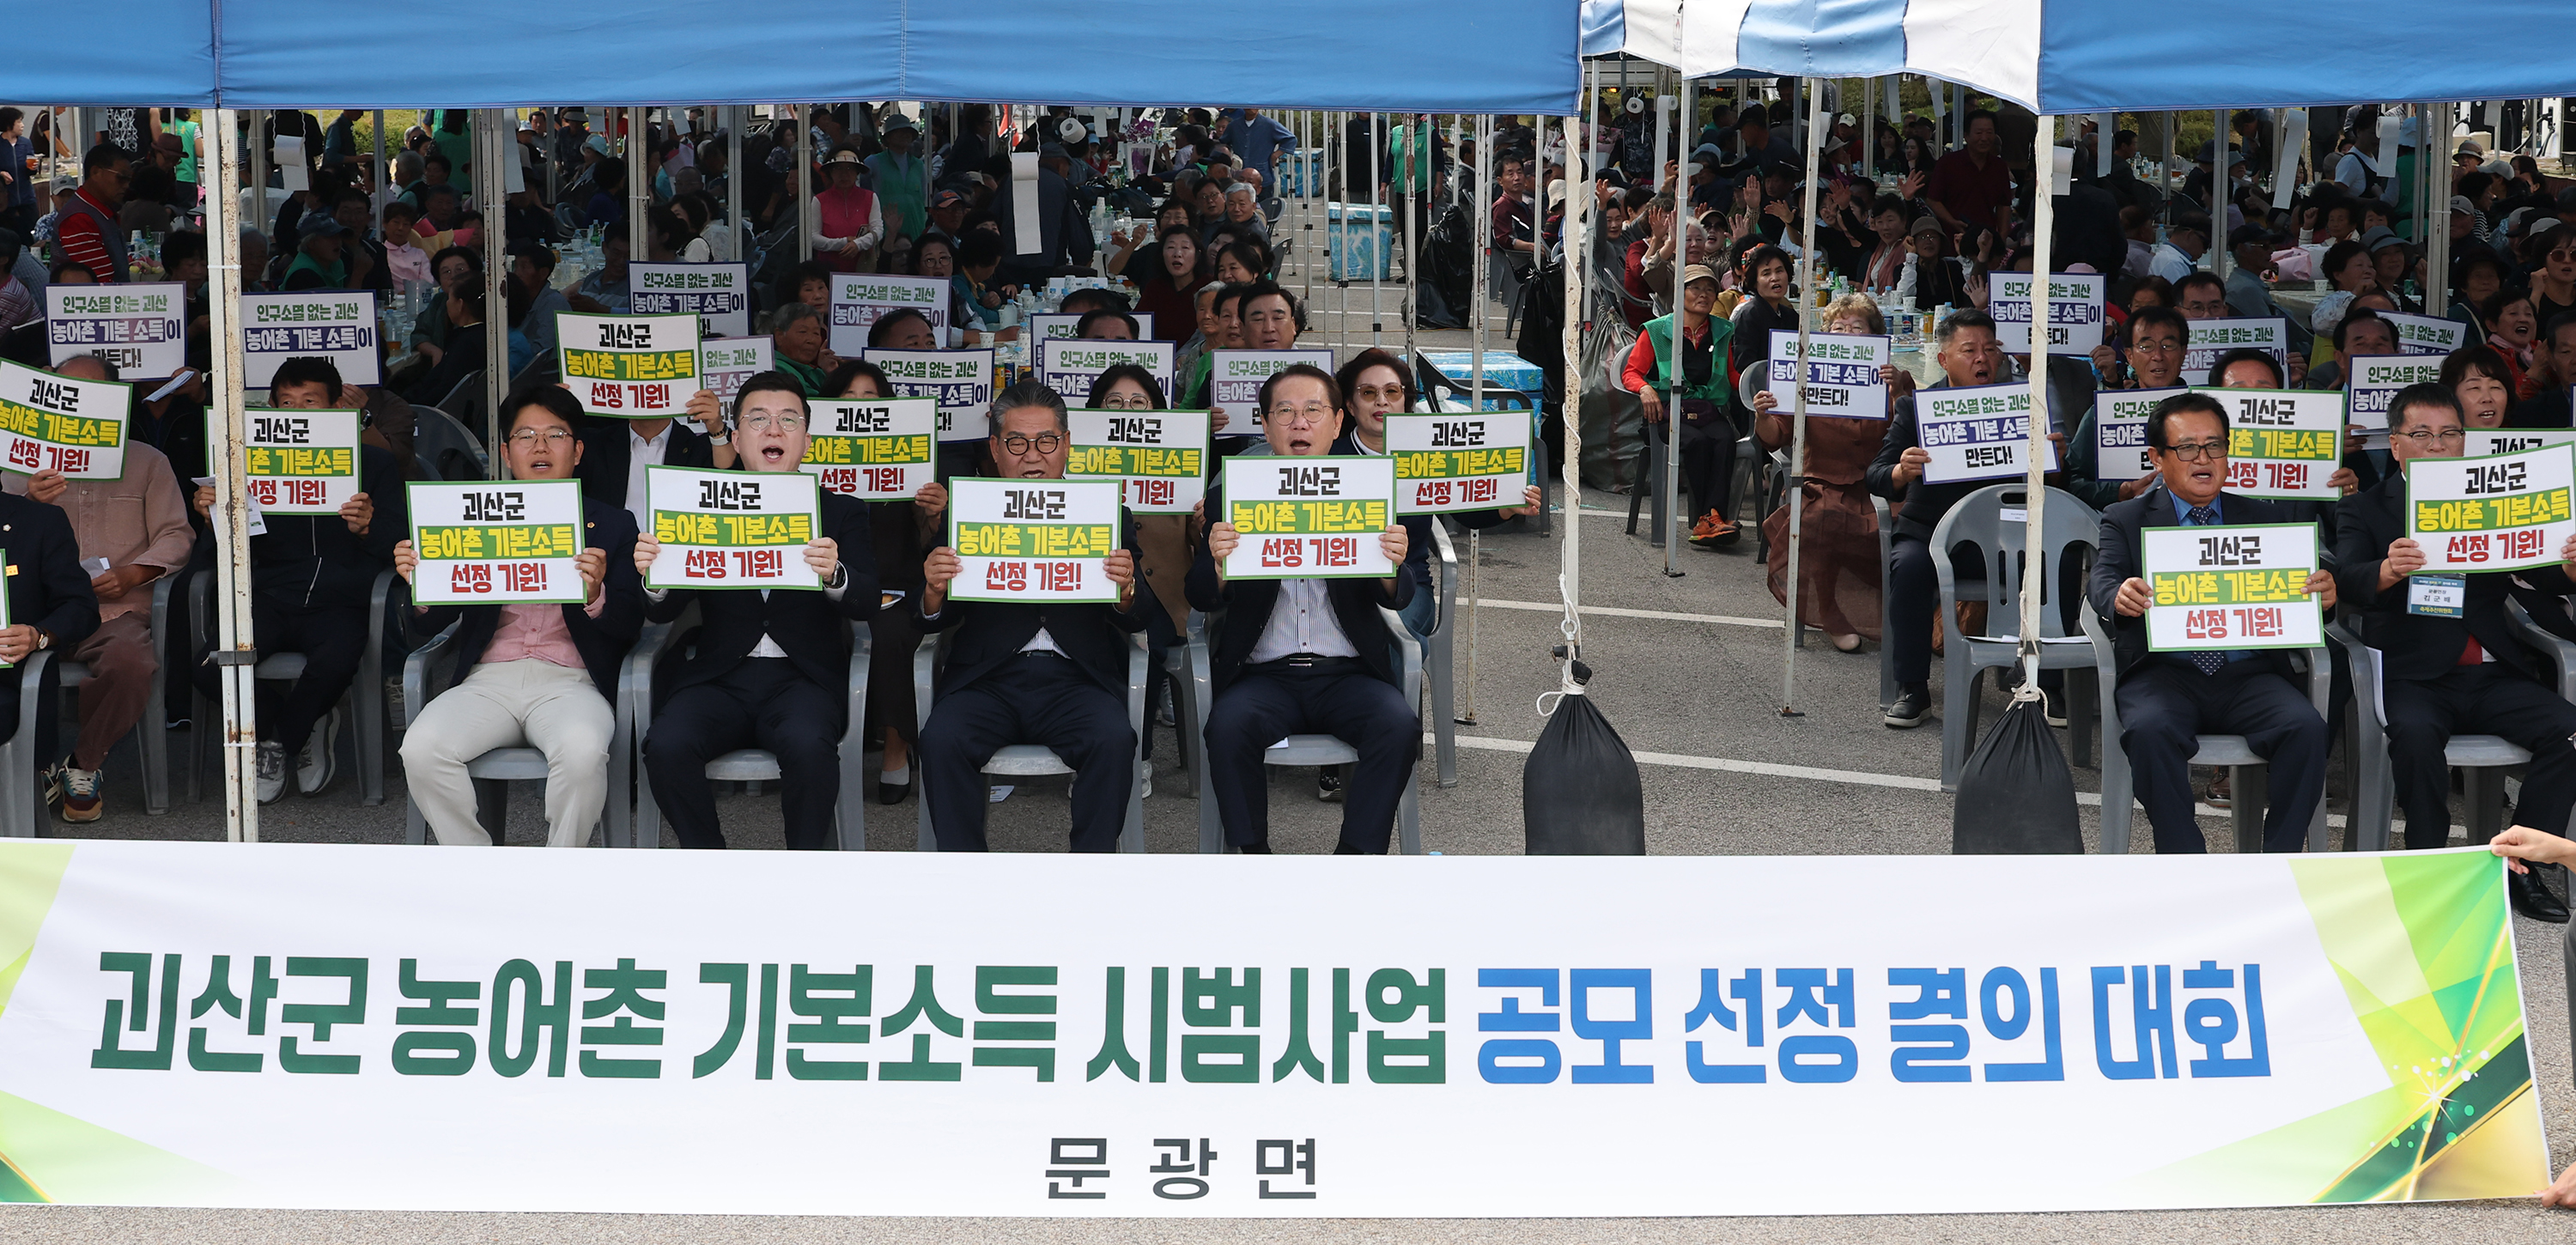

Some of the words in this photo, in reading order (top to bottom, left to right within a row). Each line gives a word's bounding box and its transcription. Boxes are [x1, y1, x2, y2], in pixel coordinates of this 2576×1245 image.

[106, 108, 134, 119] HARD
[644, 272, 684, 288] 인구소멸
[687, 273, 708, 288] 없는
[711, 272, 732, 288] 괴산
[2070, 283, 2091, 299] 괴산
[63, 295, 112, 314] 인구소멸
[114, 295, 139, 313] 없는
[143, 295, 167, 313] 괴산
[634, 294, 671, 313] 농어촌
[674, 294, 700, 313] 기본
[703, 293, 744, 313] 소득이
[846, 284, 888, 301] 인구소멸
[890, 285, 911, 301] 없는
[914, 287, 935, 302] 괴산
[257, 304, 304, 322] 인구소멸
[307, 303, 331, 321] 없는
[334, 302, 358, 320] 괴산
[835, 304, 873, 325] 농어촌
[1994, 302, 2032, 321] 농어촌
[2063, 304, 2100, 323] 소득이
[52, 319, 95, 343] 농어촌
[99, 320, 129, 342] 기본
[134, 319, 181, 341] 소득이
[246, 328, 290, 351] 농어촌
[293, 328, 323, 349] 기본
[326, 327, 373, 349] 소득이
[598, 324, 651, 349] 괴산군
[2189, 328, 2229, 345] 인구소멸
[2232, 327, 2252, 343] 없는
[2254, 326, 2274, 343] 괴산
[2417, 325, 2437, 343] 없는
[2437, 328, 2454, 345] 괴산
[706, 350, 730, 368] 없는
[733, 348, 756, 366] 괴산
[1060, 350, 1106, 368] 인구소멸
[1785, 341, 1827, 358] 인소멸
[1829, 343, 1850, 360] 없는
[1853, 345, 1874, 361] 괴산
[566, 350, 616, 379] 농어촌
[619, 351, 693, 380] 기본소득
[880, 360, 927, 378] 인구소멸
[929, 361, 952, 379] 없는
[955, 361, 978, 378] 괴산
[1228, 361, 1271, 376] 인구소멸
[1815, 364, 1841, 383] 기본
[2368, 366, 2414, 384] 인구소멸
[2417, 365, 2439, 383] 없는
[29, 378, 79, 412] 괴산군
[591, 382, 623, 409] 선정
[628, 384, 670, 409] 기원!
[945, 384, 988, 406] 소득이
[1048, 374, 1090, 396] 농어촌
[1218, 382, 1256, 401] 농어촌
[1807, 387, 1849, 406] 만든다!
[1933, 398, 1979, 417] 인구소멸
[1981, 397, 2005, 415] 없는
[2008, 393, 2030, 411] 괴산
[2239, 398, 2295, 425] 괴산군
[0, 401, 39, 437] 농어촌
[44, 413, 118, 446] 기본소득
[253, 418, 309, 443] 괴산군
[836, 408, 890, 433] 괴산군
[1108, 418, 1162, 443] 괴산군
[1924, 422, 1967, 446] 농어촌
[1970, 420, 1999, 441] 기본
[1431, 422, 1485, 446] 괴산군
[2102, 423, 2145, 446] 농어촌
[2259, 430, 2334, 459] 기본소득
[9, 438, 41, 468] 선정
[46, 446, 89, 472] 기원!
[857, 435, 928, 463] 기본소득
[1068, 446, 1122, 473] 농어촌
[1128, 448, 1200, 476] 기본소득
[1965, 446, 2014, 468] 만든다!
[276, 449, 351, 475] 기본소득
[1394, 452, 1447, 477] 농어촌
[1452, 448, 1522, 475] 기본소득
[821, 468, 856, 493] 선정
[863, 468, 904, 492] 기원!
[1279, 467, 1340, 495] 괴산군
[2264, 464, 2307, 489] 기원!
[2465, 461, 2526, 495] 괴산군
[283, 480, 326, 505] 기원!
[699, 480, 761, 510] 괴산군
[1004, 490, 1066, 519] 괴산군
[1133, 480, 1174, 505] 기원!
[1416, 481, 1451, 506] 선정
[1457, 479, 1498, 502] 기원!
[462, 492, 525, 521] 괴산군
[1234, 501, 1296, 532] 농어촌
[1302, 501, 1385, 531] 기본소득
[2418, 500, 2483, 531] 농어촌
[2489, 489, 2569, 527] 기본소득
[656, 513, 718, 544] 농어촌
[723, 515, 810, 544] 기본소득
[959, 525, 1021, 555] 농어촌
[1027, 525, 1110, 556] 기본소득
[421, 527, 483, 558] 농어촌
[488, 525, 573, 556] 기본소득
[1261, 538, 1303, 567] 선정
[1309, 537, 1357, 567] 기원!
[2199, 536, 2261, 566] 괴산군
[2447, 534, 2489, 563] 선정
[2497, 529, 2544, 560] 기원!
[685, 550, 726, 578] 선정
[732, 550, 783, 578] 기원!
[986, 562, 1027, 591] 선정
[1034, 562, 1081, 591] 기원!
[452, 563, 492, 592] 선정
[498, 562, 547, 592] 기원!
[2155, 572, 2219, 604] 농어촌
[2223, 570, 2309, 602] 기본소득
[2186, 609, 2227, 639] 선정
[2233, 608, 2283, 637] 기원!
[90, 950, 369, 1075] 괴산군
[391, 957, 668, 1079] 농어촌
[691, 962, 1058, 1083] 기본소득
[1085, 966, 1446, 1084] 시범사업
[1477, 967, 1655, 1084] 공모
[1685, 967, 1859, 1084] 선정
[1887, 965, 2066, 1083] 결의
[2090, 960, 2272, 1081] 대회
